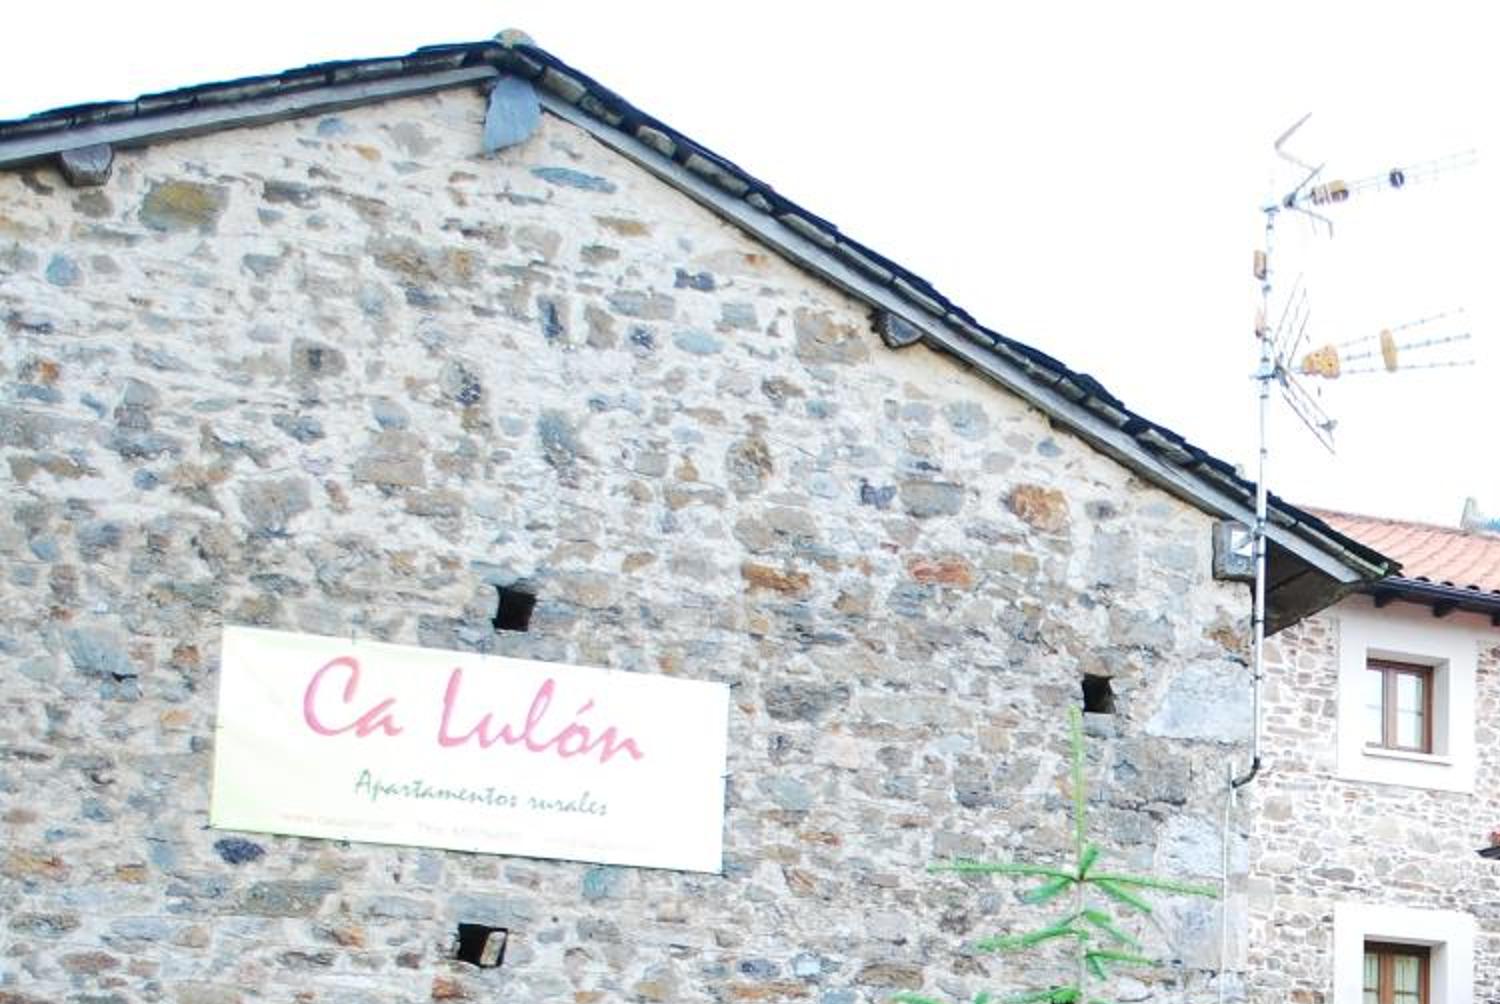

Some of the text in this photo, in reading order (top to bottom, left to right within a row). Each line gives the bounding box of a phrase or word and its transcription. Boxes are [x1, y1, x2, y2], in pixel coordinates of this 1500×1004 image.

[304, 657, 645, 762] Ca Lulón
[354, 769, 608, 817] Apartamentos rurales
